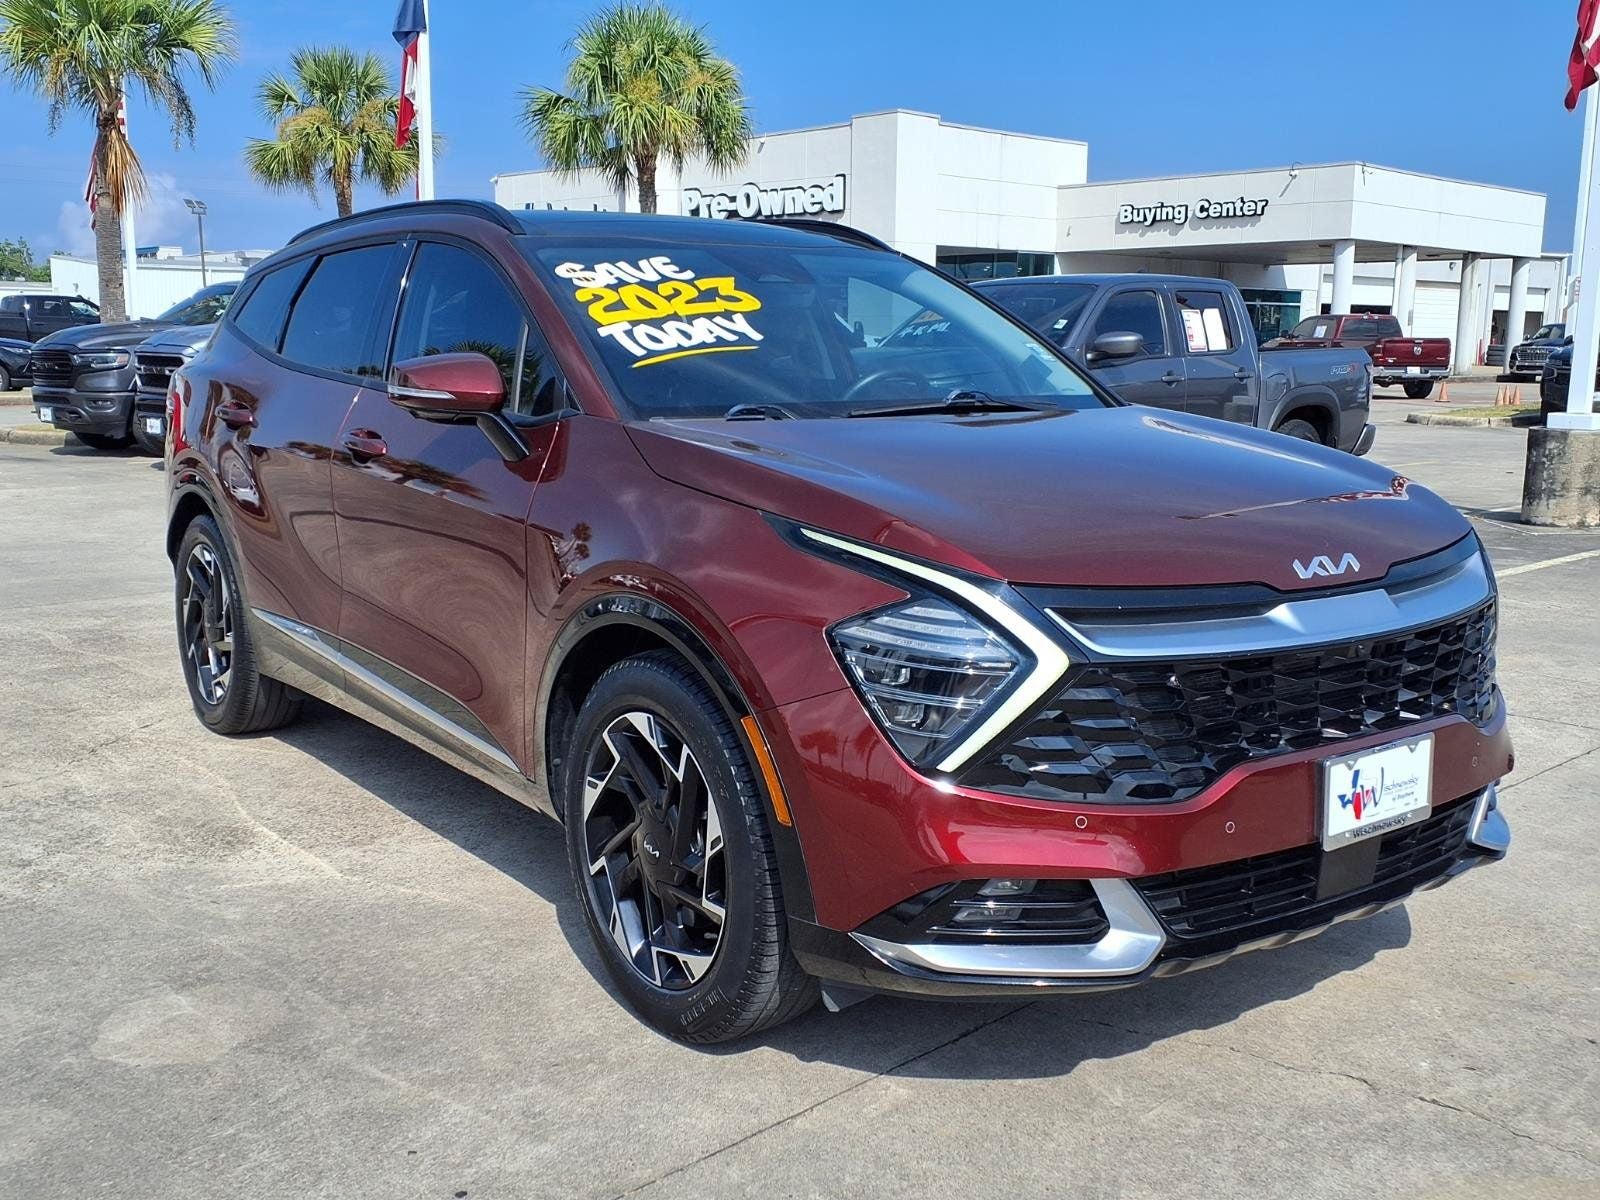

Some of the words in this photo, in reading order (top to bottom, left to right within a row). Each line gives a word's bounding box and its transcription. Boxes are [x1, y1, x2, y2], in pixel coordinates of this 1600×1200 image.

[681, 174, 846, 219] Pre-Owned
[1119, 202, 1188, 226] Buying
[1194, 197, 1268, 218] Center
[575, 277, 762, 325] 2023
[597, 313, 764, 356] TODAY
[1292, 552, 1360, 579] KIA
